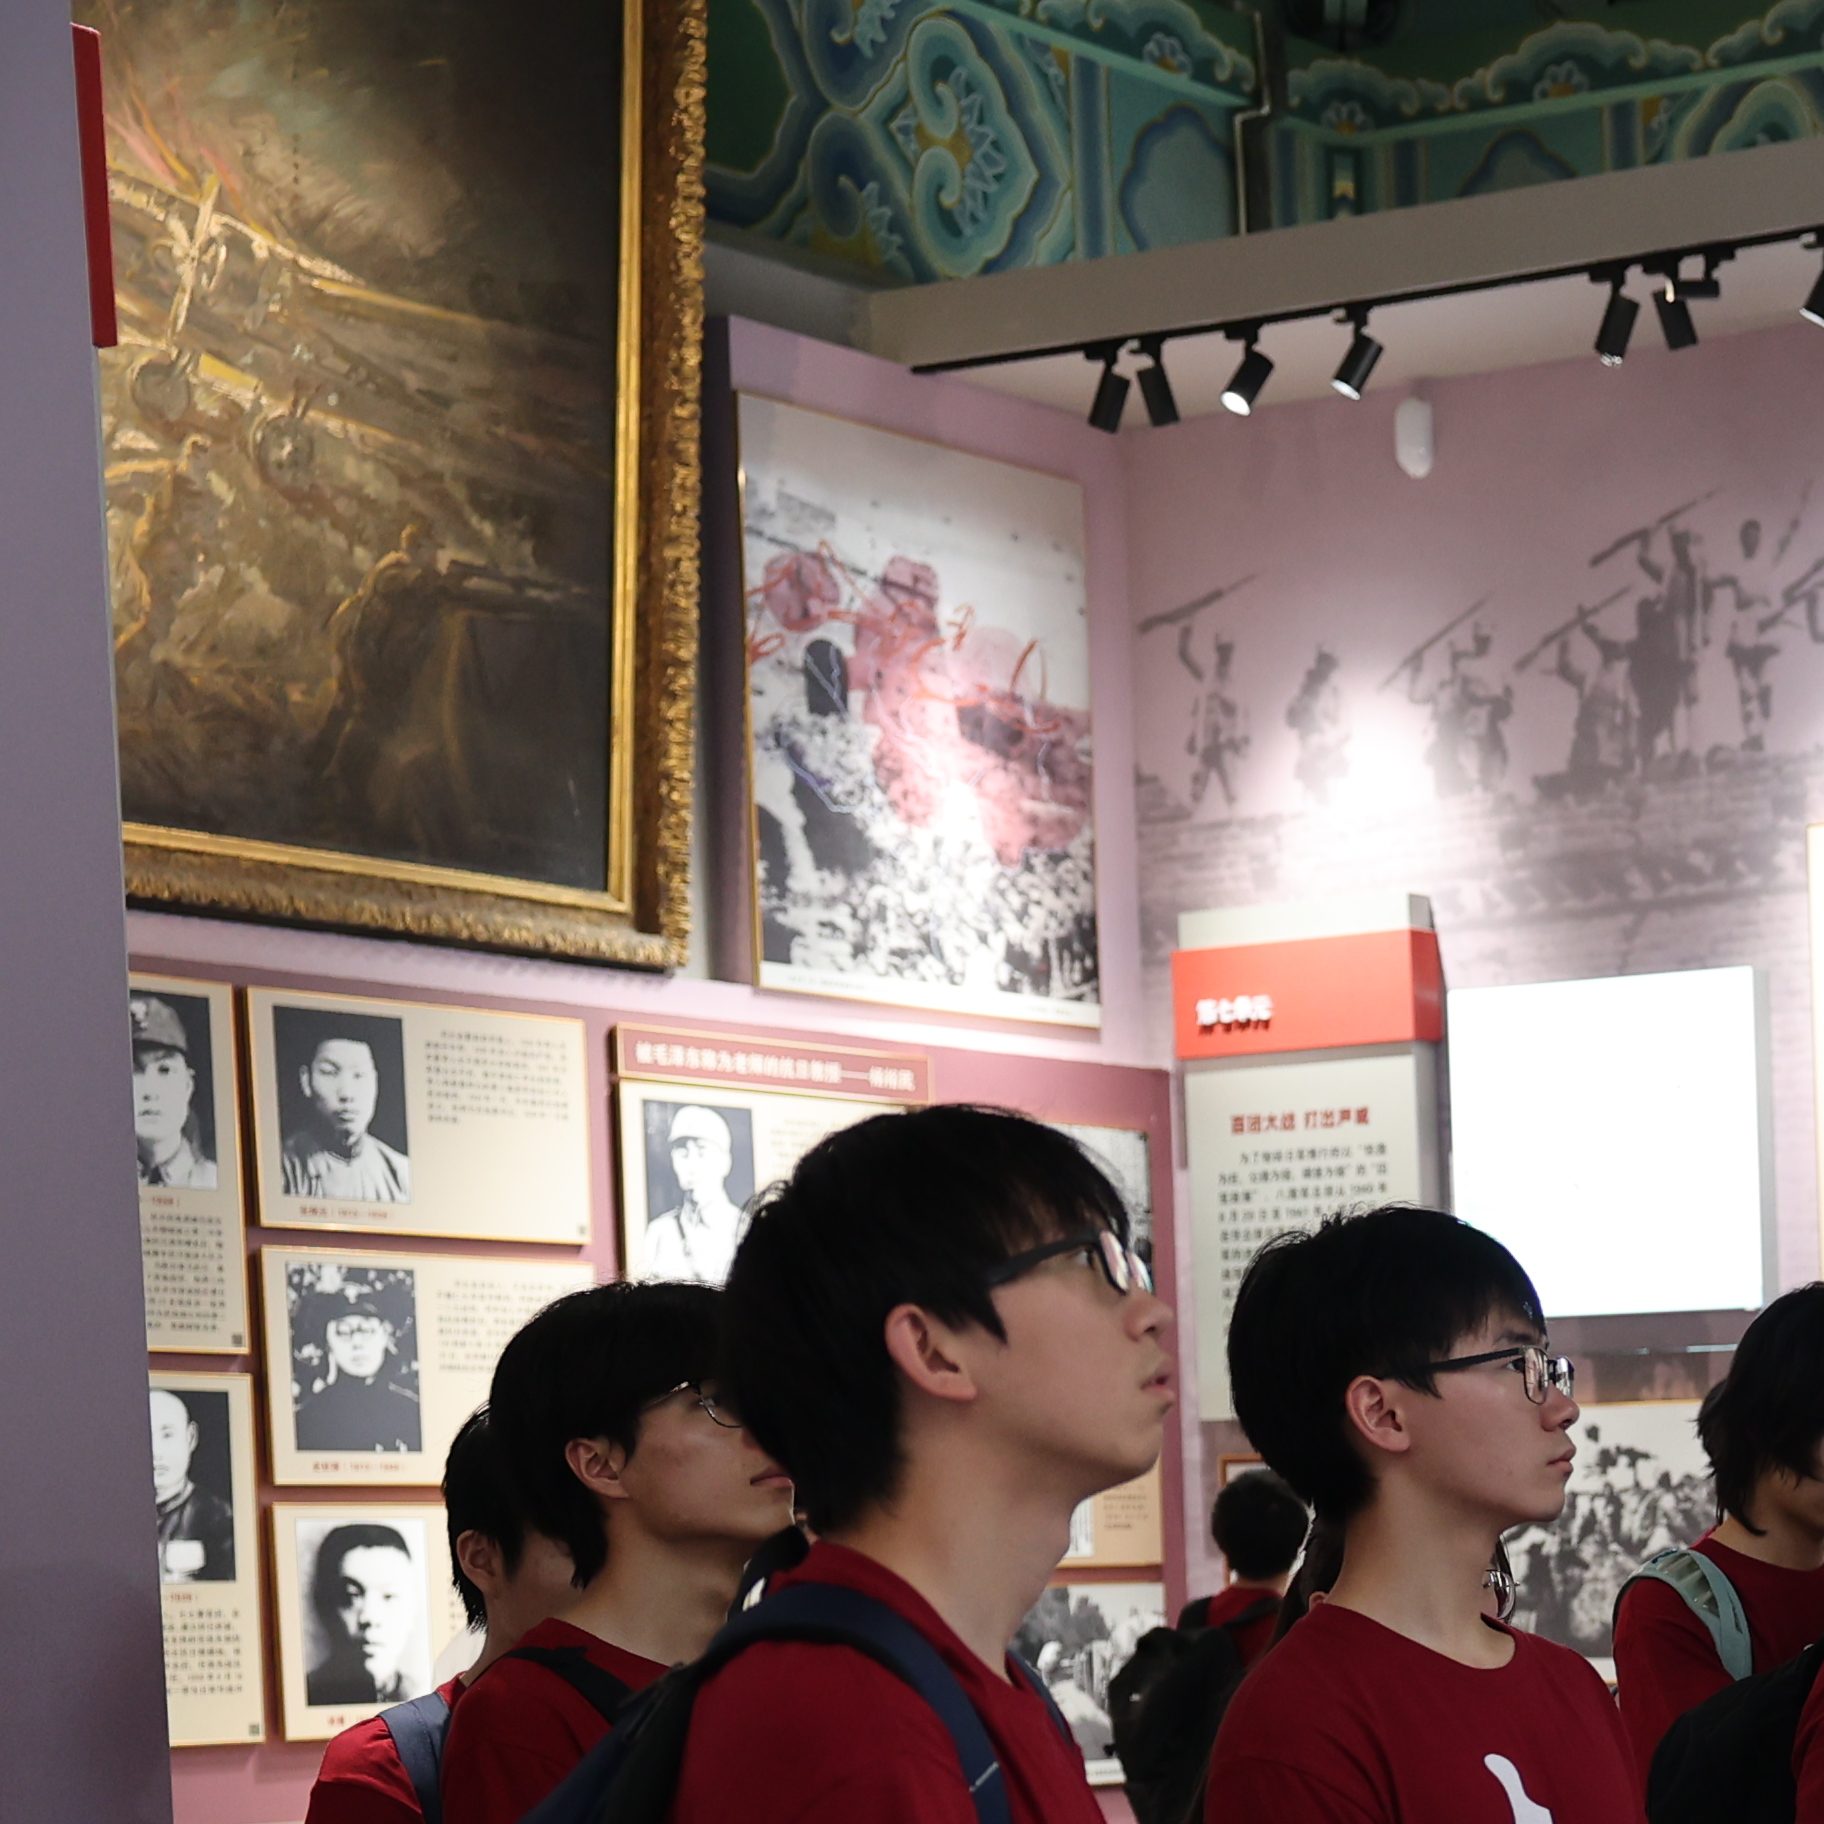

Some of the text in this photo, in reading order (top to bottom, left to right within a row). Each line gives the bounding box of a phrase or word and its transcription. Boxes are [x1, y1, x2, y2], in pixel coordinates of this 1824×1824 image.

[1231, 1106, 1370, 1135] 百团大战 打出声威
